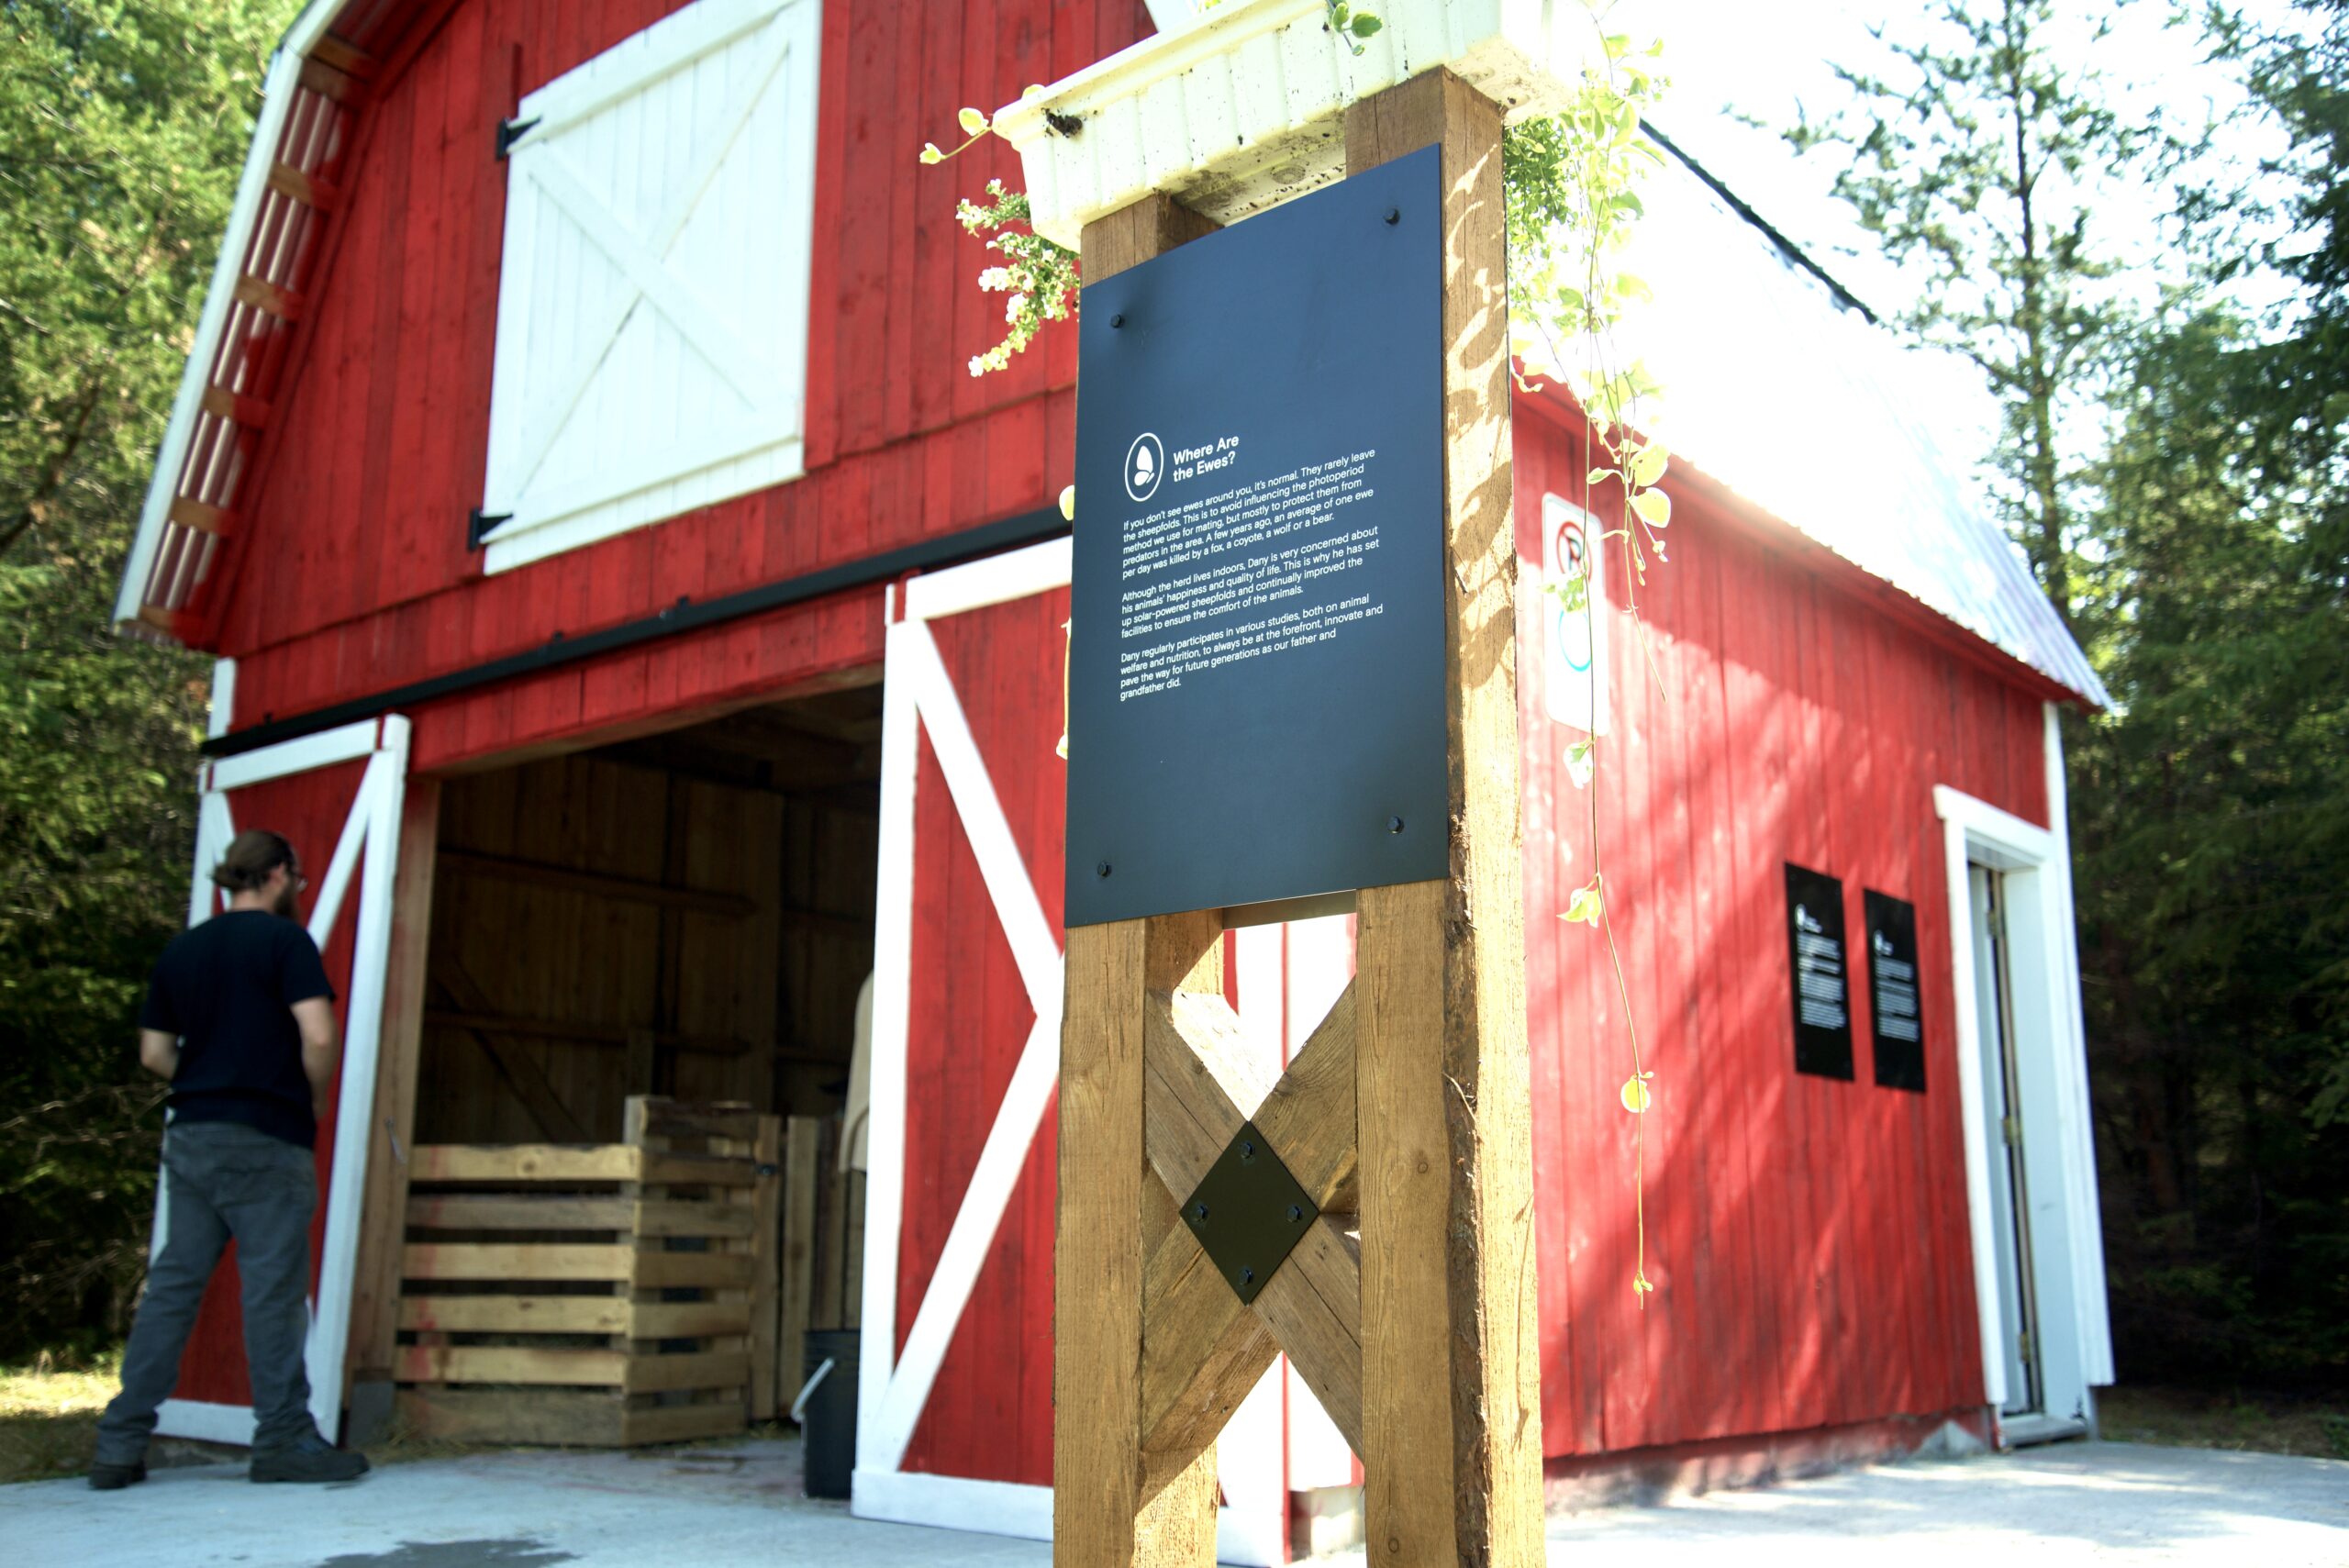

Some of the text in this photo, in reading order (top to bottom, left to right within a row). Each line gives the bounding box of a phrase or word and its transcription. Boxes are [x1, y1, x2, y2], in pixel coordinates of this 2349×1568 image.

[1173, 435, 1239, 465] Where Are
[1173, 451, 1235, 482] the Ewes?
[1123, 449, 1375, 531] If you don't see ewes around you, it's normal. They rarely leave
[1123, 463, 1364, 543] the sheepfolds. This is to avoid influencing the photoperiod
[1123, 478, 1362, 554] method we use for mating, but mostly to protect them from
[1121, 525, 1378, 602] Although the herd lives indoors, Dany is very concerned about
[1123, 488, 1373, 569] predators in the area. A few years ago, an average of one ewe
[1123, 512, 1334, 580] per day was killed by a fox, a coyote, a wolf or a bear.
[1122, 538, 1379, 614] his animals' happiness and quality of life. This is why he has set
[1122, 557, 1362, 627] up solar-powered sheepfolds and continually improved the
[1121, 585, 1303, 638] facilities to ensure the comfort of the animals.
[1121, 594, 1369, 663] Dany regularly participates in various studies, both on animal
[1121, 605, 1382, 675] welfare and nutrition, to always be at the forefront, innovate and
[1120, 629, 1337, 689] pave the way for future generations as our father and
[1120, 677, 1181, 701] grandfather did.
